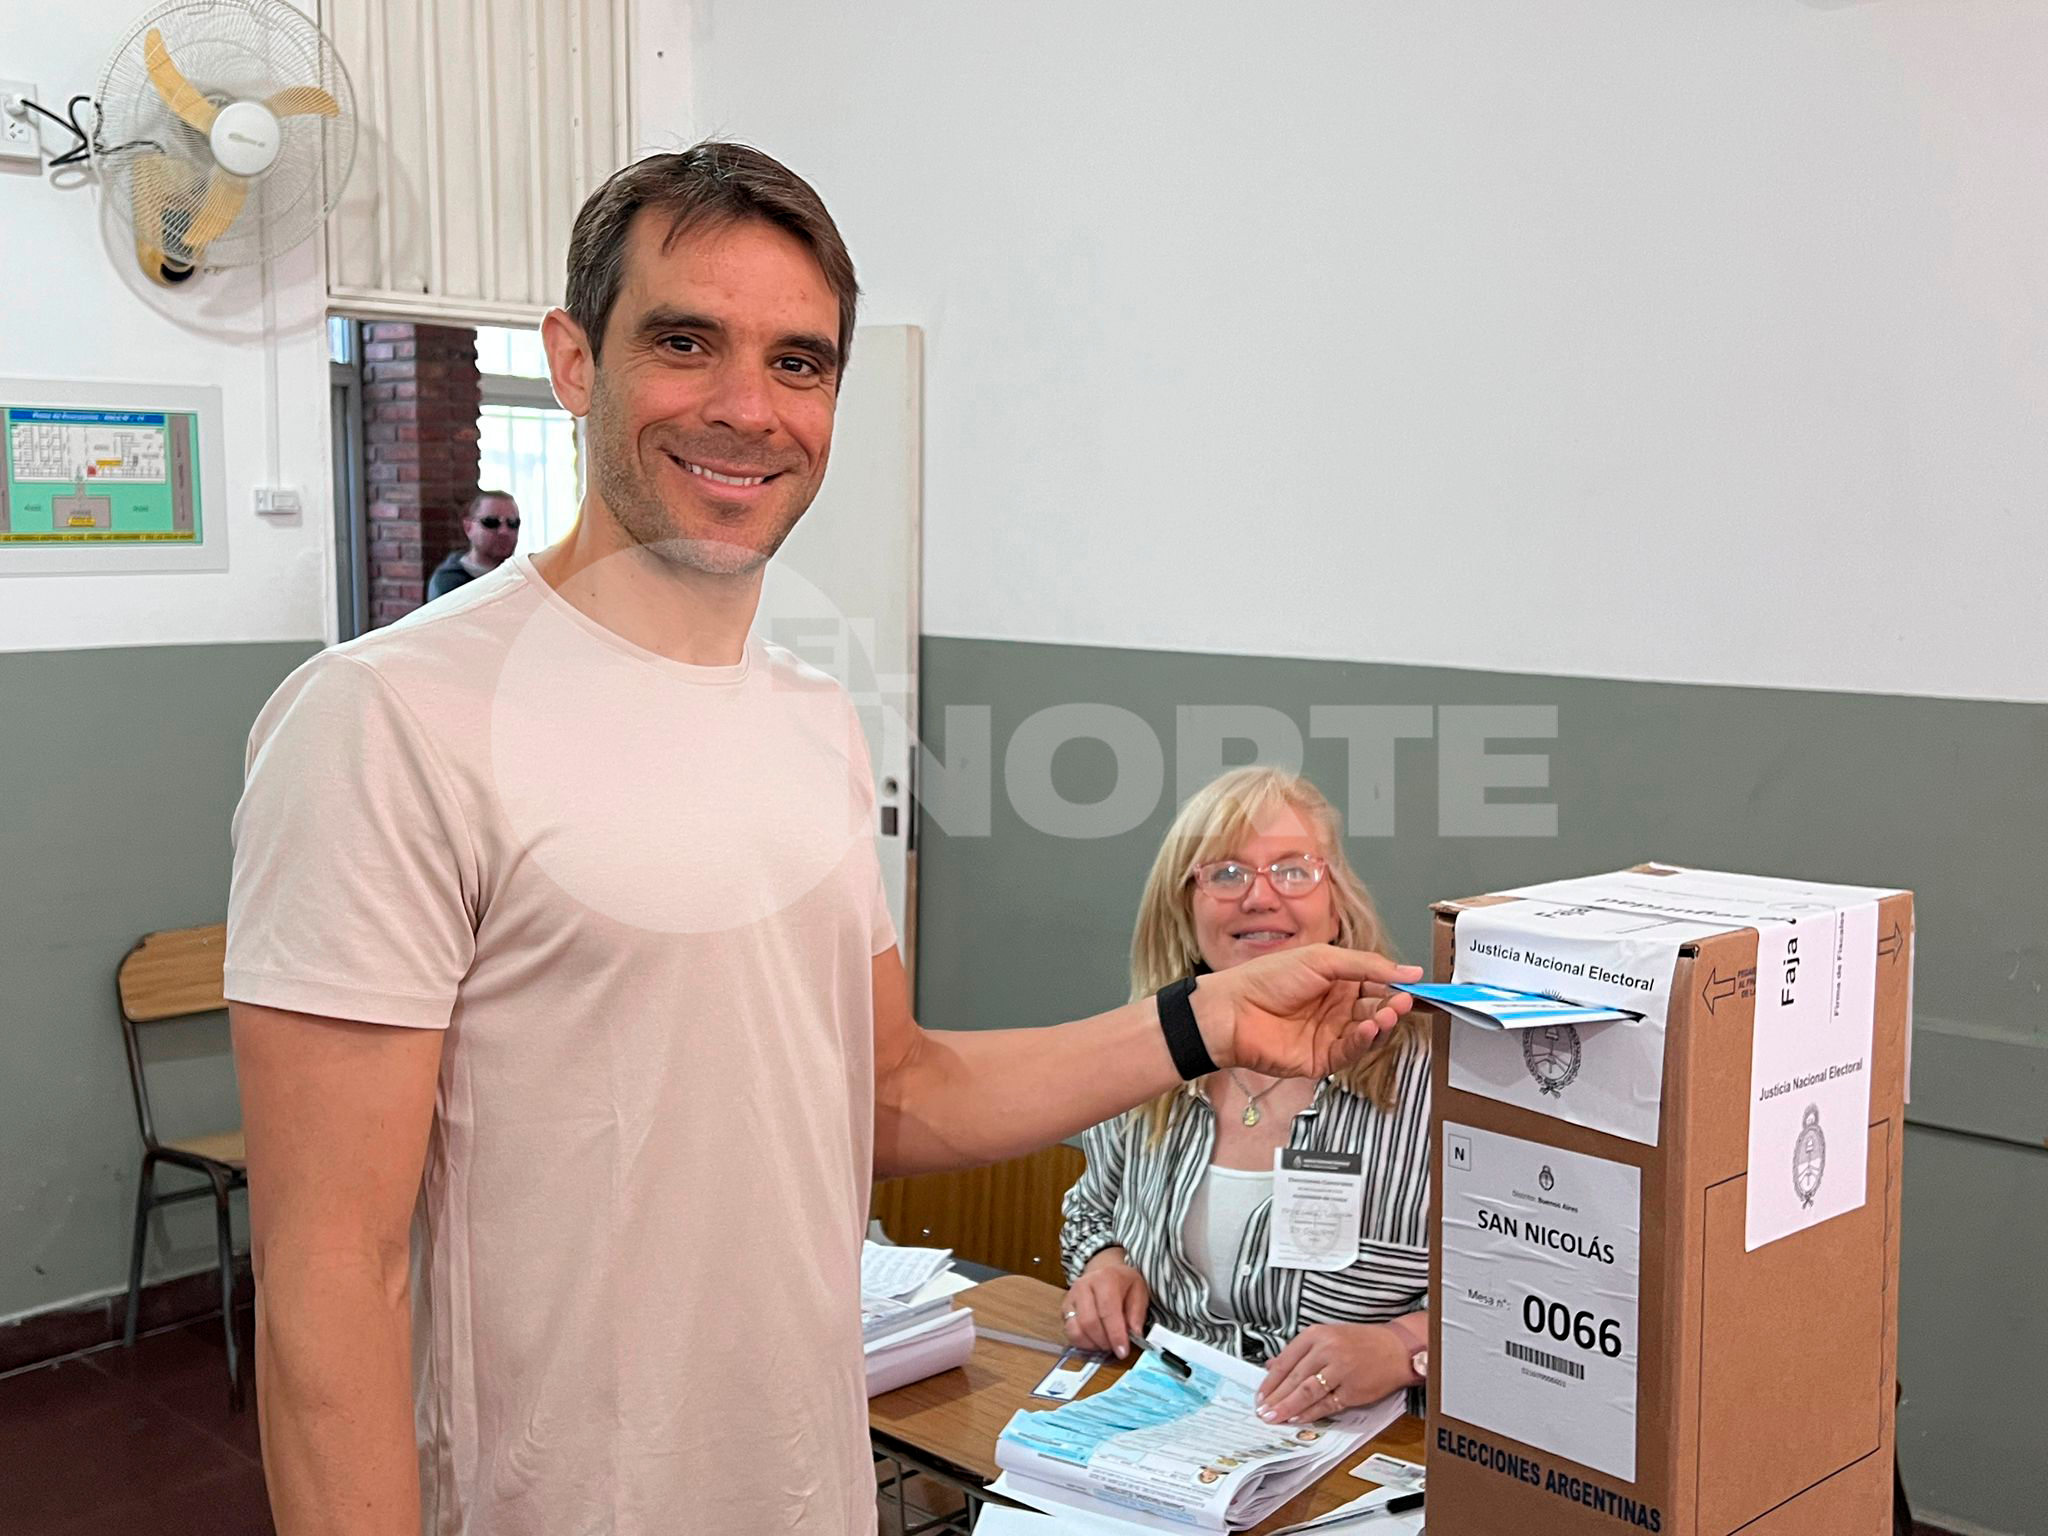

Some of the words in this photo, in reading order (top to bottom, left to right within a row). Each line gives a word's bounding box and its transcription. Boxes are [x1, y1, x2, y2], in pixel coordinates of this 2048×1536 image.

[1837, 912, 1845, 961] Fiscales
[1469, 940, 1521, 962] Justicia
[1524, 951, 1584, 977] Nacional
[1589, 966, 1655, 992] Electoral
[1781, 937, 1800, 1007] Faja
[1836, 964, 1842, 979] de
[1833, 982, 1841, 1017] Firma
[1759, 1081, 1791, 1101] Justicia
[1793, 1068, 1827, 1089] Nacional
[1829, 1057, 1863, 1079] Electoral
[1454, 1147, 1465, 1161] N
[1478, 1209, 1517, 1238] SAN
[1525, 1222, 1615, 1264] NICOLÁS
[1467, 1288, 1494, 1306] Mesa
[1523, 1294, 1622, 1358] 0066
[1437, 1427, 1540, 1486] ELECCIONES
[1545, 1469, 1662, 1533] ARGENTINAS
